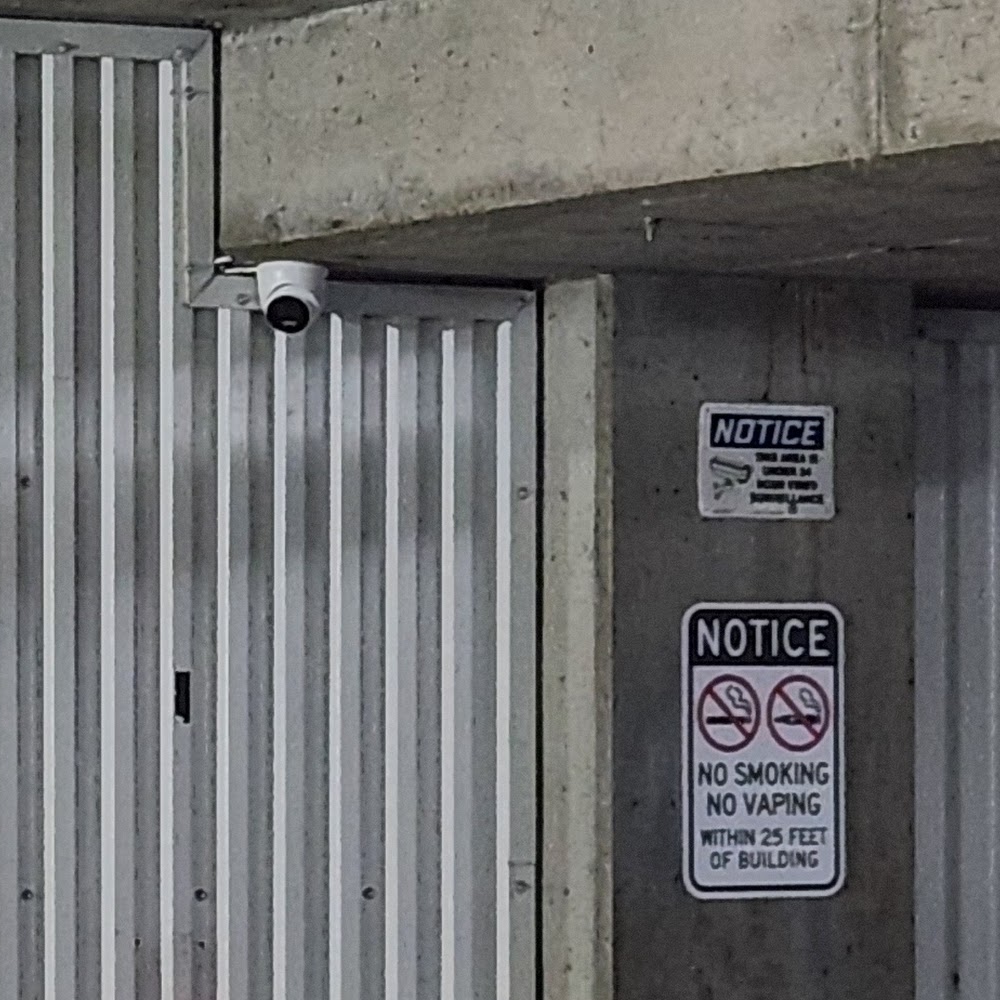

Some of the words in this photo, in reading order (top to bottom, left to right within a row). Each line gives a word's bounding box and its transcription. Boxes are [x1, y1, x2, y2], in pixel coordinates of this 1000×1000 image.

[714, 418, 820, 446] NOTICE
[697, 617, 831, 658] NOTICE
[698, 761, 728, 786] NO
[734, 761, 830, 786] SMOKING
[706, 792, 738, 817] NO
[743, 792, 822, 816] VAPING
[700, 828, 756, 847] WITHIN
[760, 828, 784, 847] 25
[788, 826, 828, 847] FEET
[710, 850, 732, 870] OF
[738, 850, 820, 870] BUILDING
